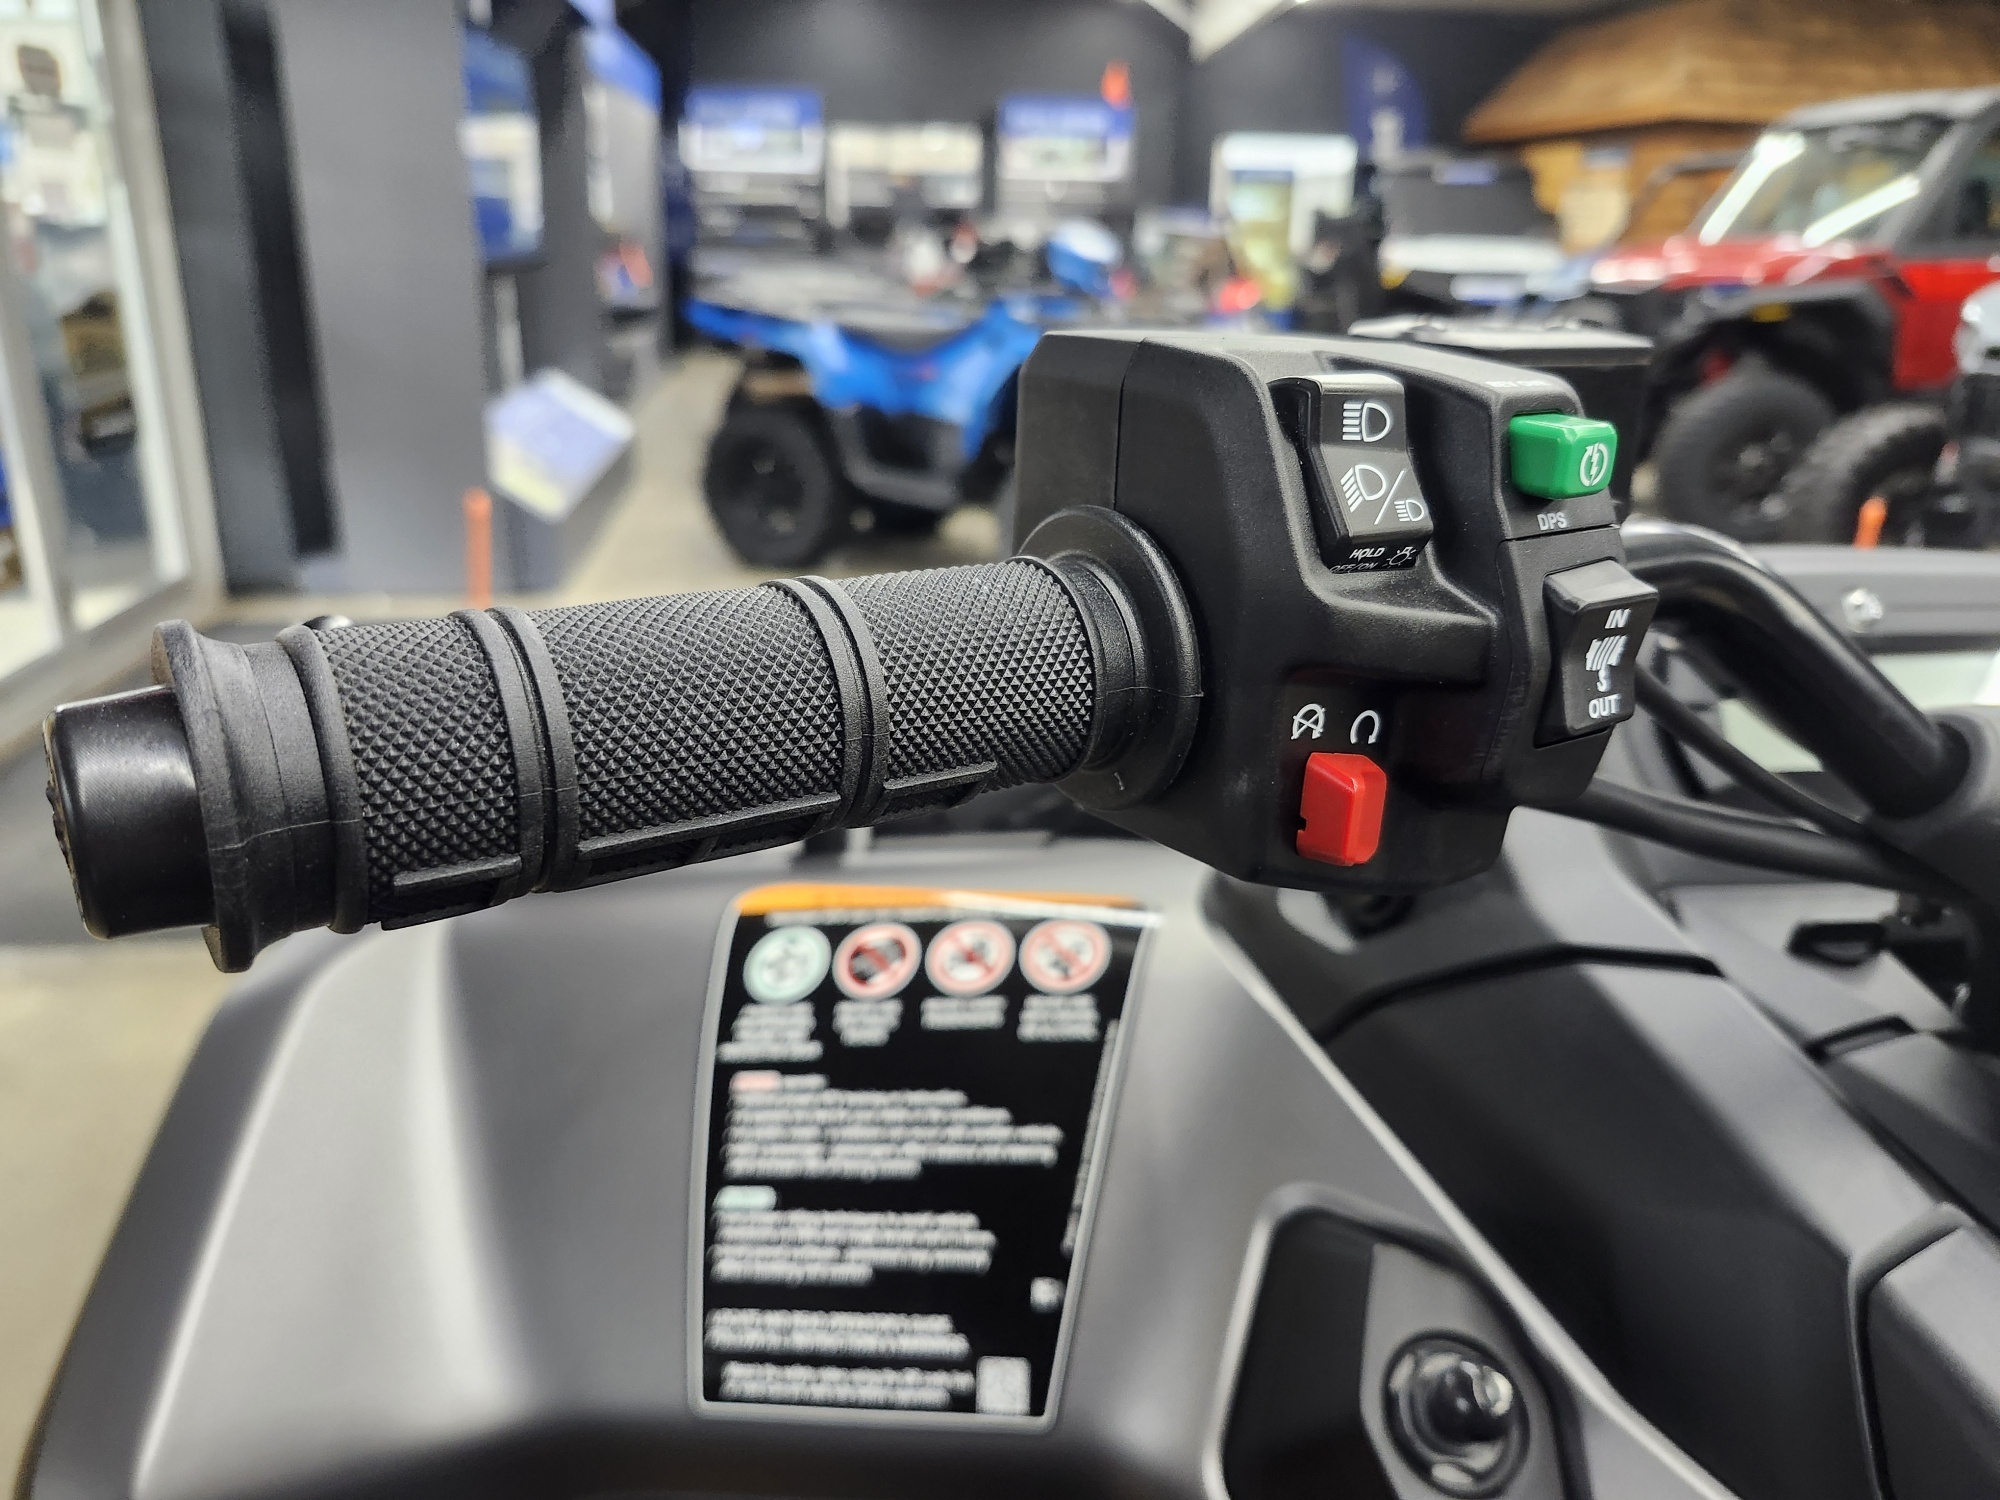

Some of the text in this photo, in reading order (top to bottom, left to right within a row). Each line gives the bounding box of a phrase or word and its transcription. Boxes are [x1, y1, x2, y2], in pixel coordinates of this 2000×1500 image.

[1537, 511, 1567, 530] DPS
[1349, 547, 1385, 560] HOLD
[1604, 608, 1631, 629] IN
[1588, 693, 1621, 719] OUT
